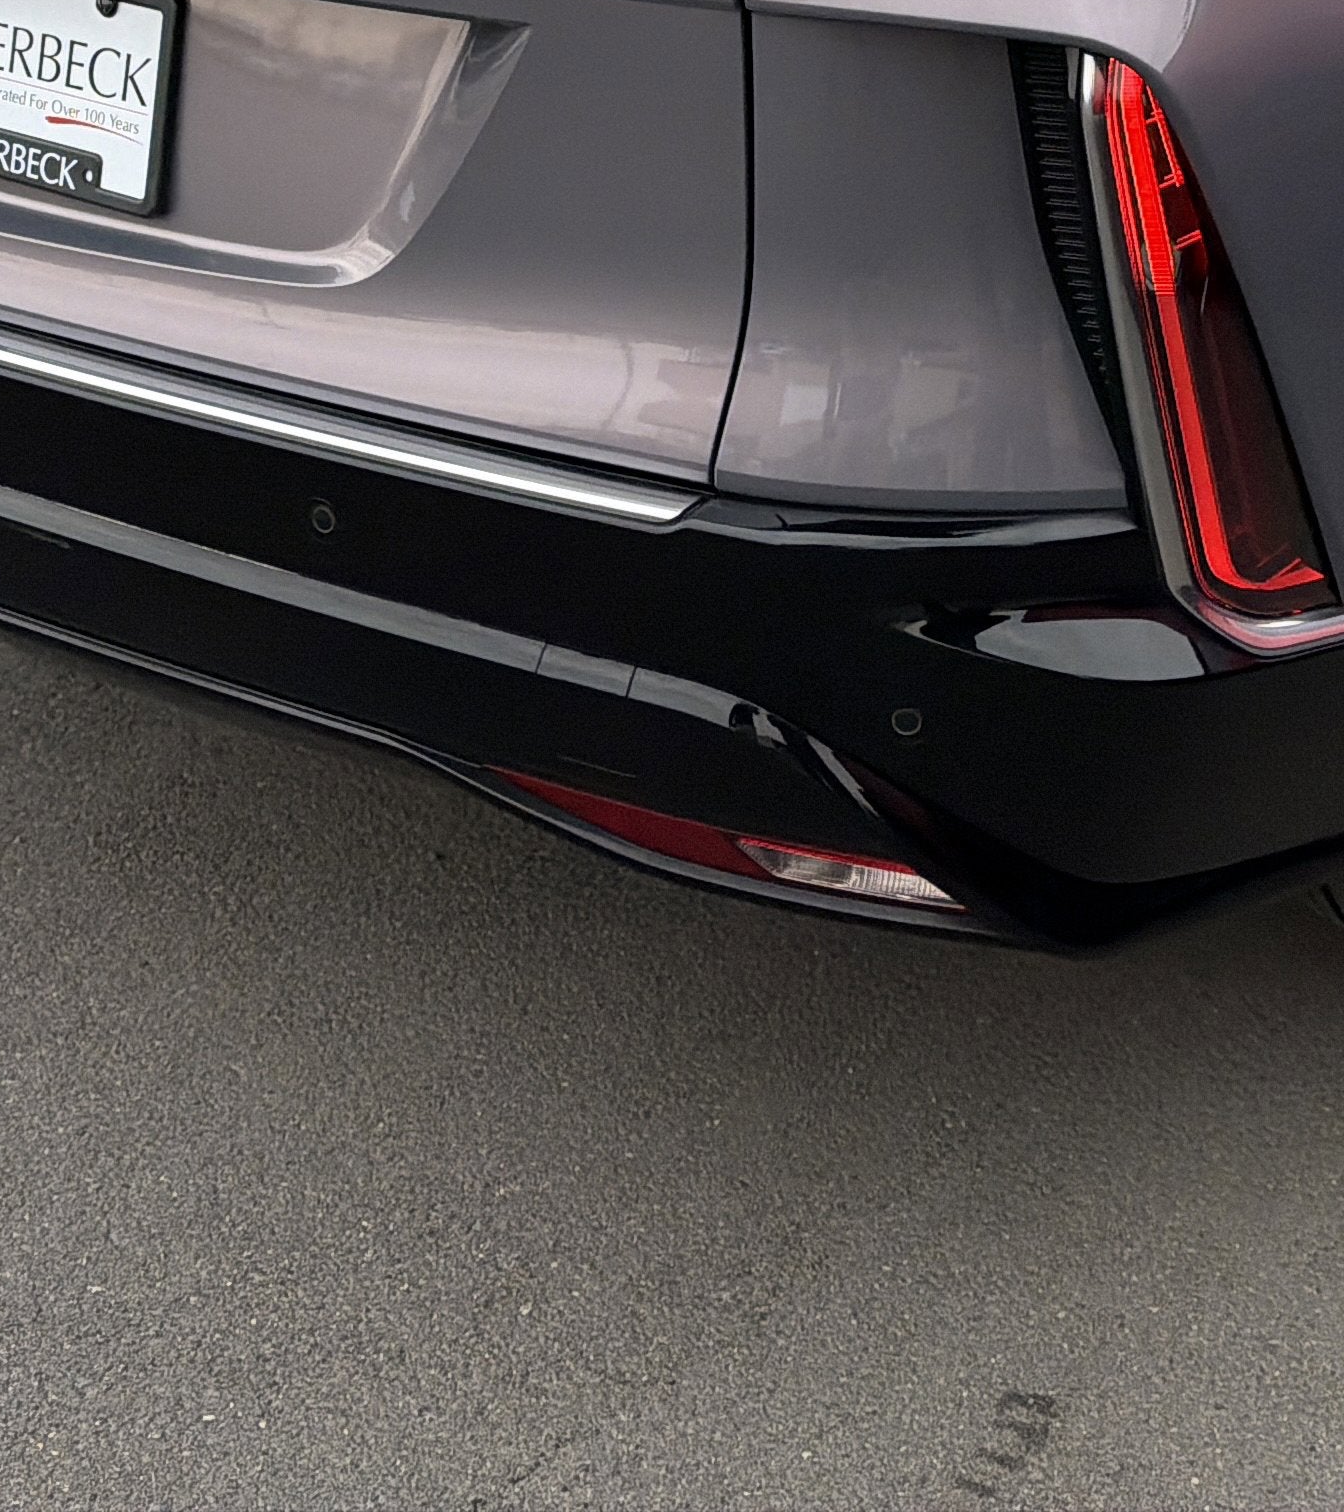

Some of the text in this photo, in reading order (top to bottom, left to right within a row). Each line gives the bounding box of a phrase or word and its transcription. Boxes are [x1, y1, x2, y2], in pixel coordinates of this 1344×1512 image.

[29, 93, 48, 110] For
[51, 99, 81, 118] Over
[84, 107, 106, 126] 100
[109, 113, 140, 135] Years
